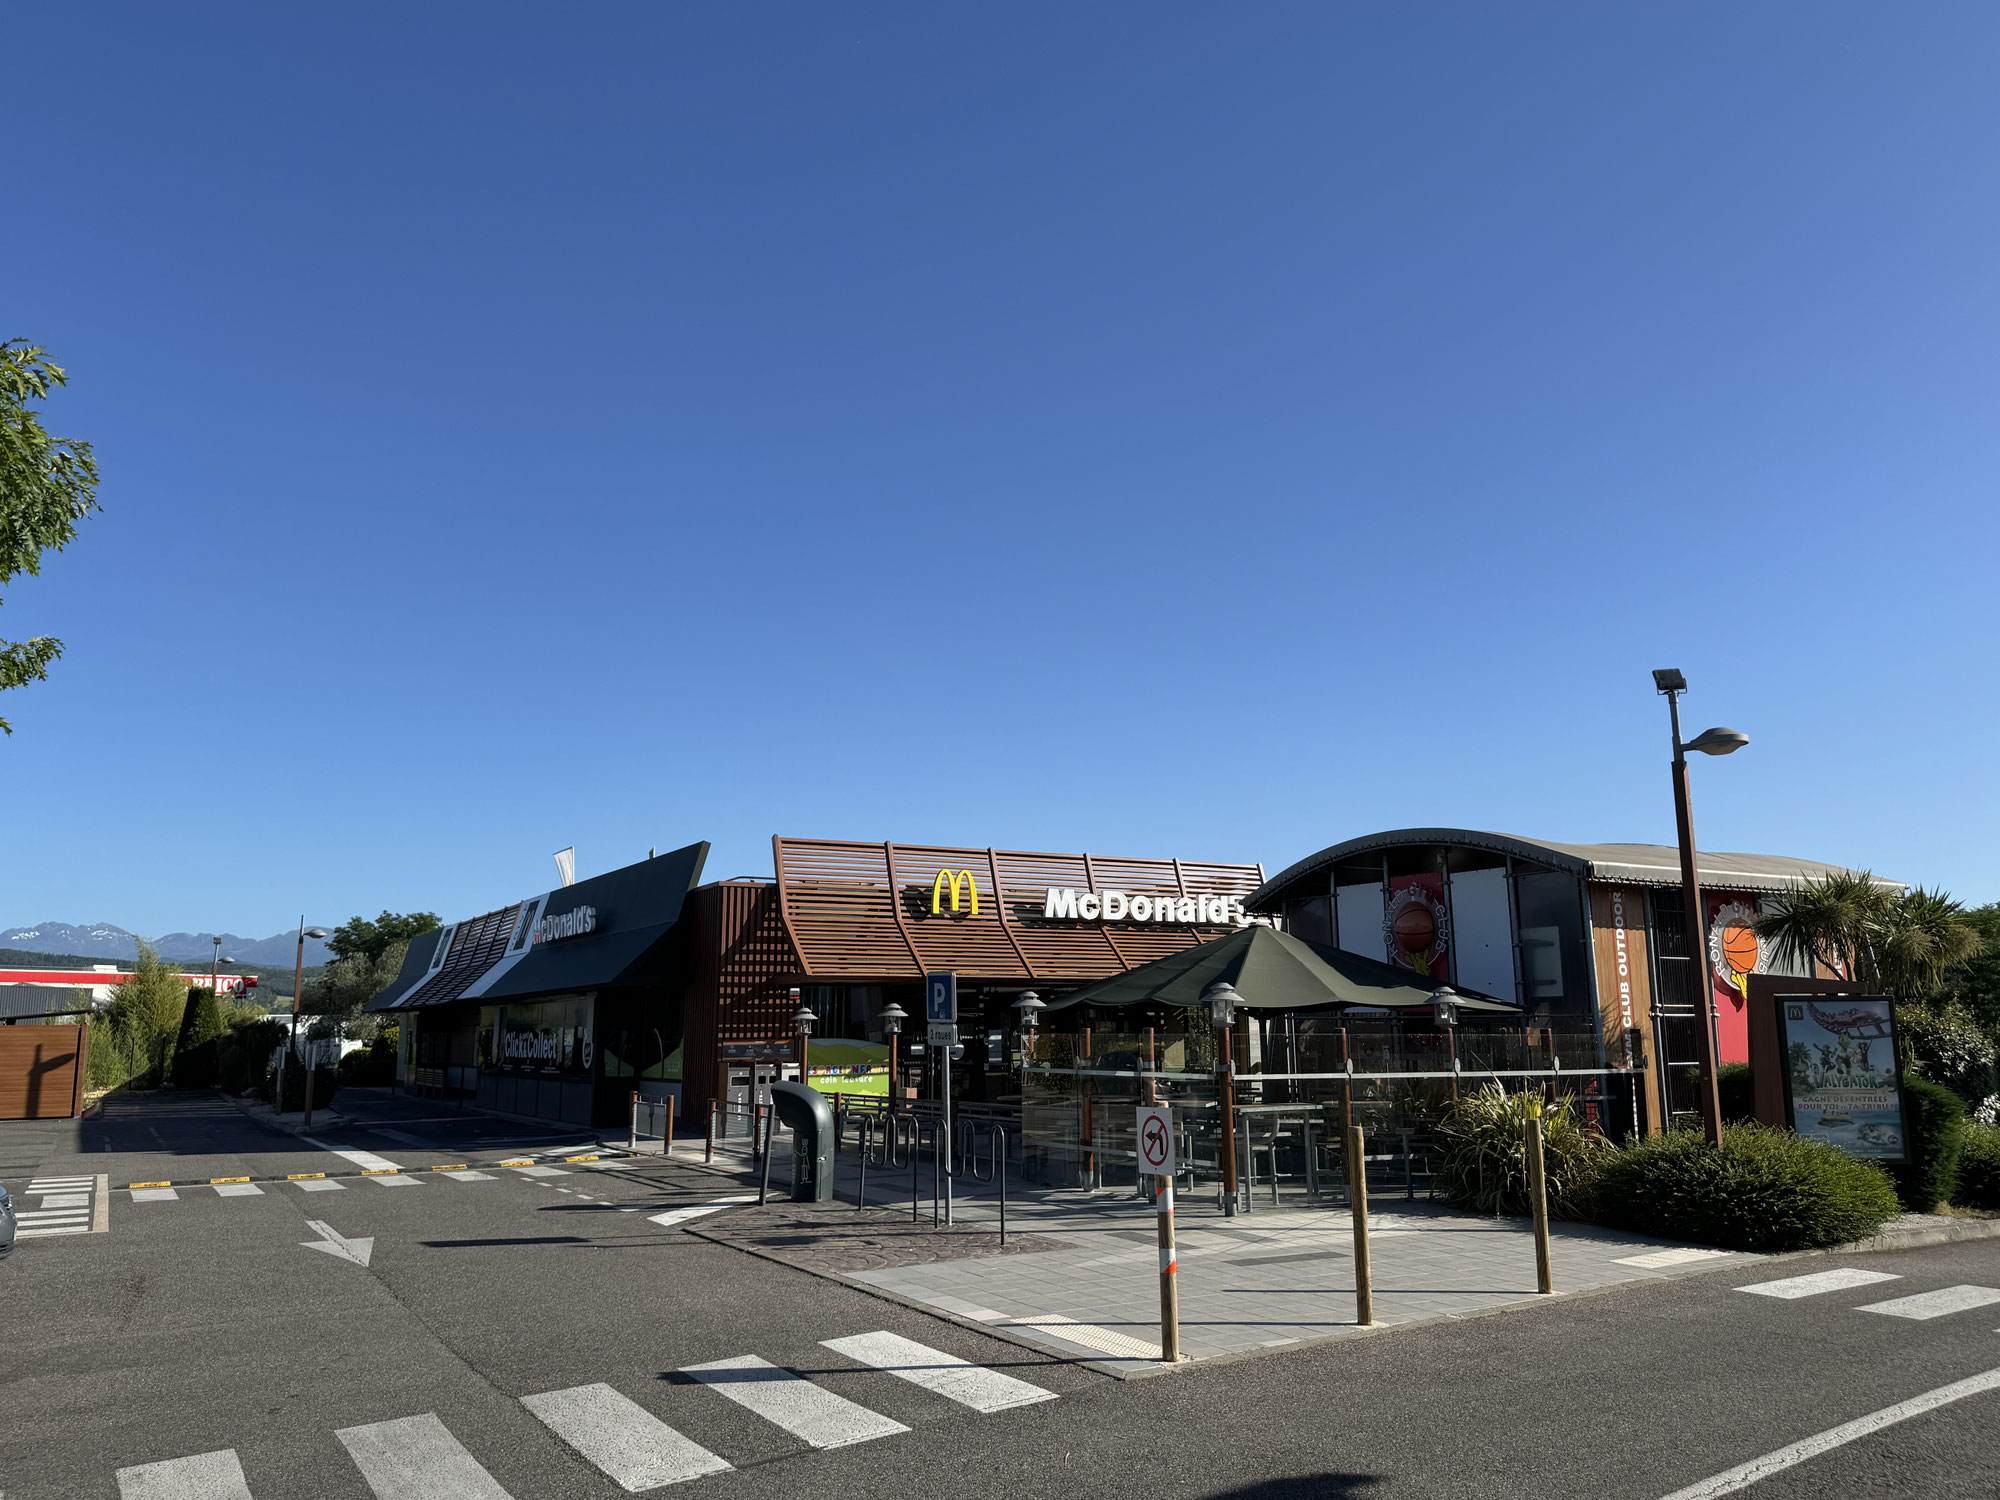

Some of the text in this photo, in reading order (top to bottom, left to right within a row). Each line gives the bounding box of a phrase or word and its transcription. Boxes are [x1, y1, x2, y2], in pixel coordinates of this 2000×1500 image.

[533, 905, 597, 944] McDonald's
[1612, 891, 1629, 976] OUTDOOR
[934, 983, 946, 1012] P
[1619, 981, 1632, 1028] CLUB
[935, 1031, 952, 1041] roues
